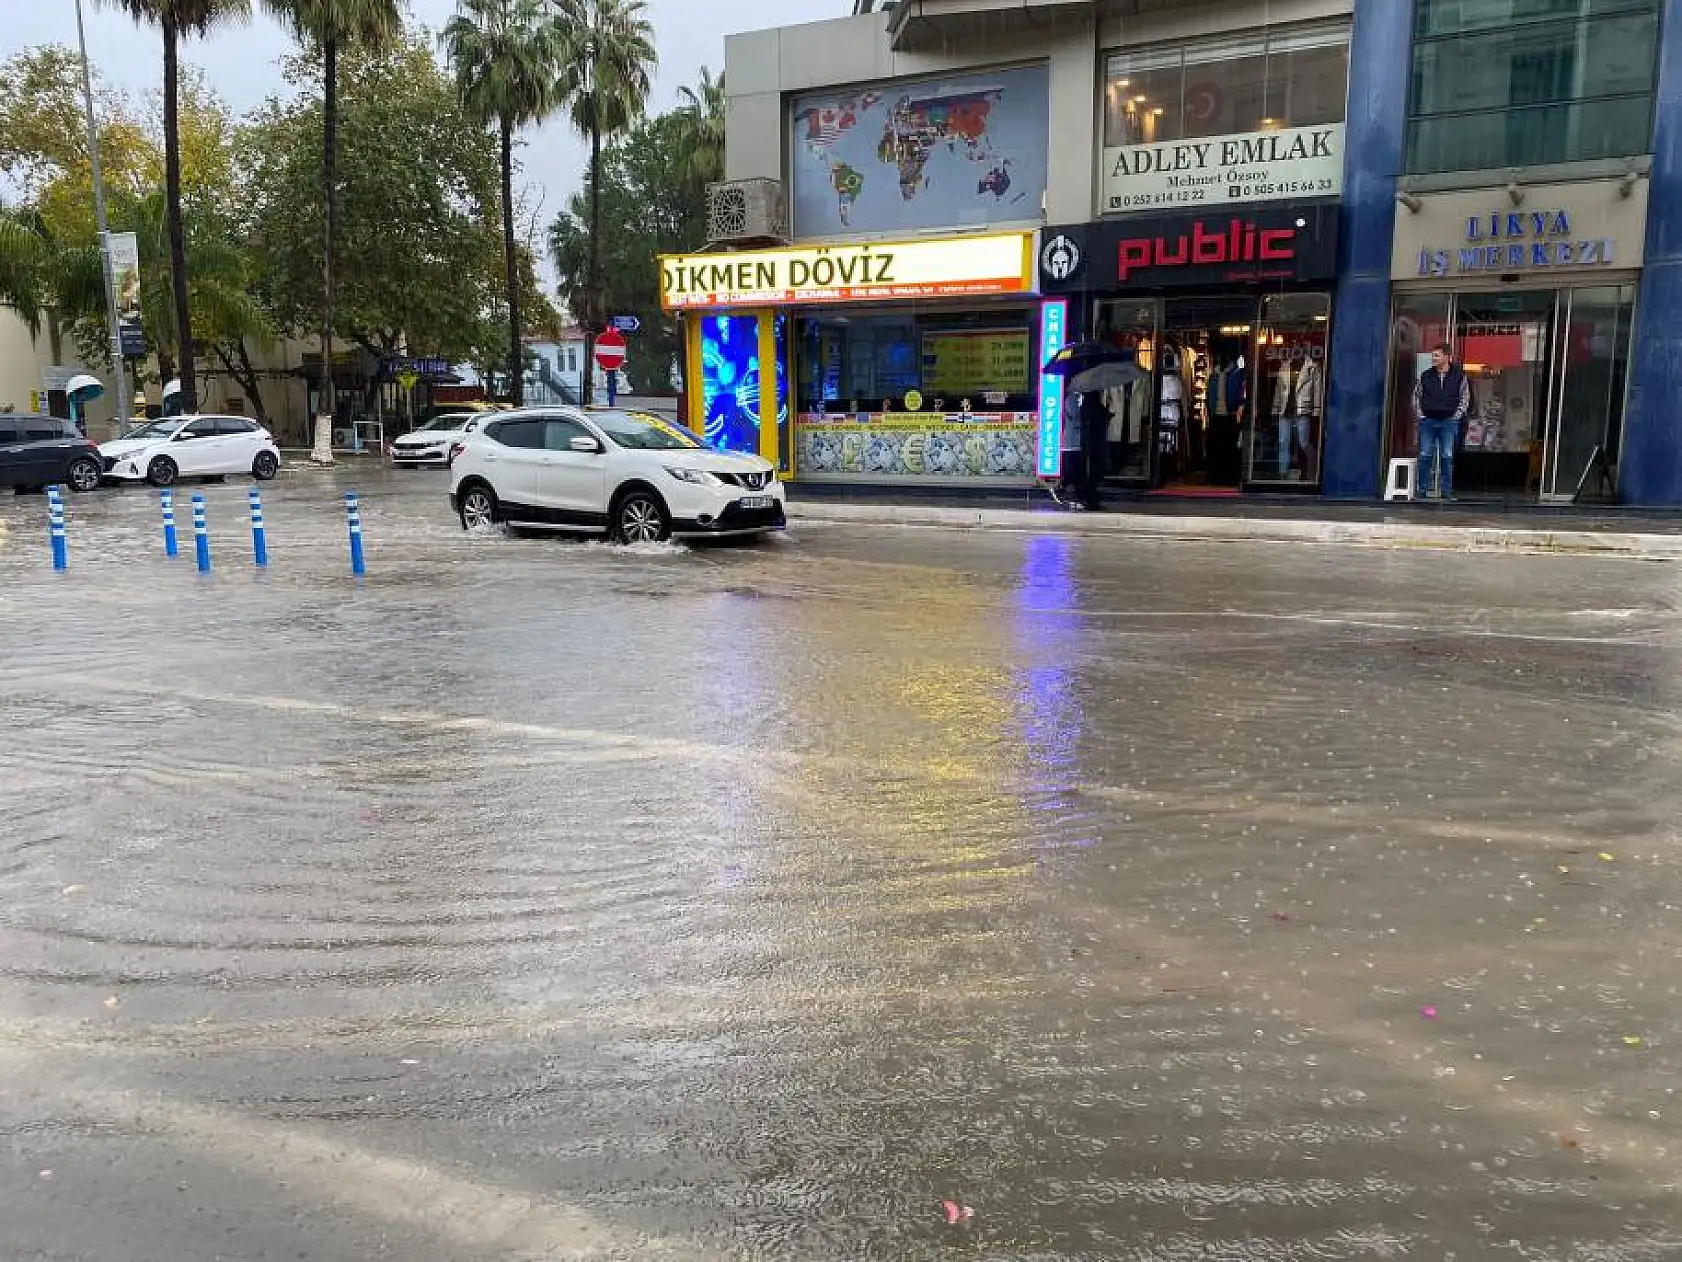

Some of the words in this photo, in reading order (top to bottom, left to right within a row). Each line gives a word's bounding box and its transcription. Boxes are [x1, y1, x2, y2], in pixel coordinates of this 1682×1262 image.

[1112, 143, 1212, 177] ADLEY
[1219, 130, 1334, 167] EMLAK
[789, 245, 895, 287] DÖVİZ
[1044, 396, 1057, 470] OFFICE
